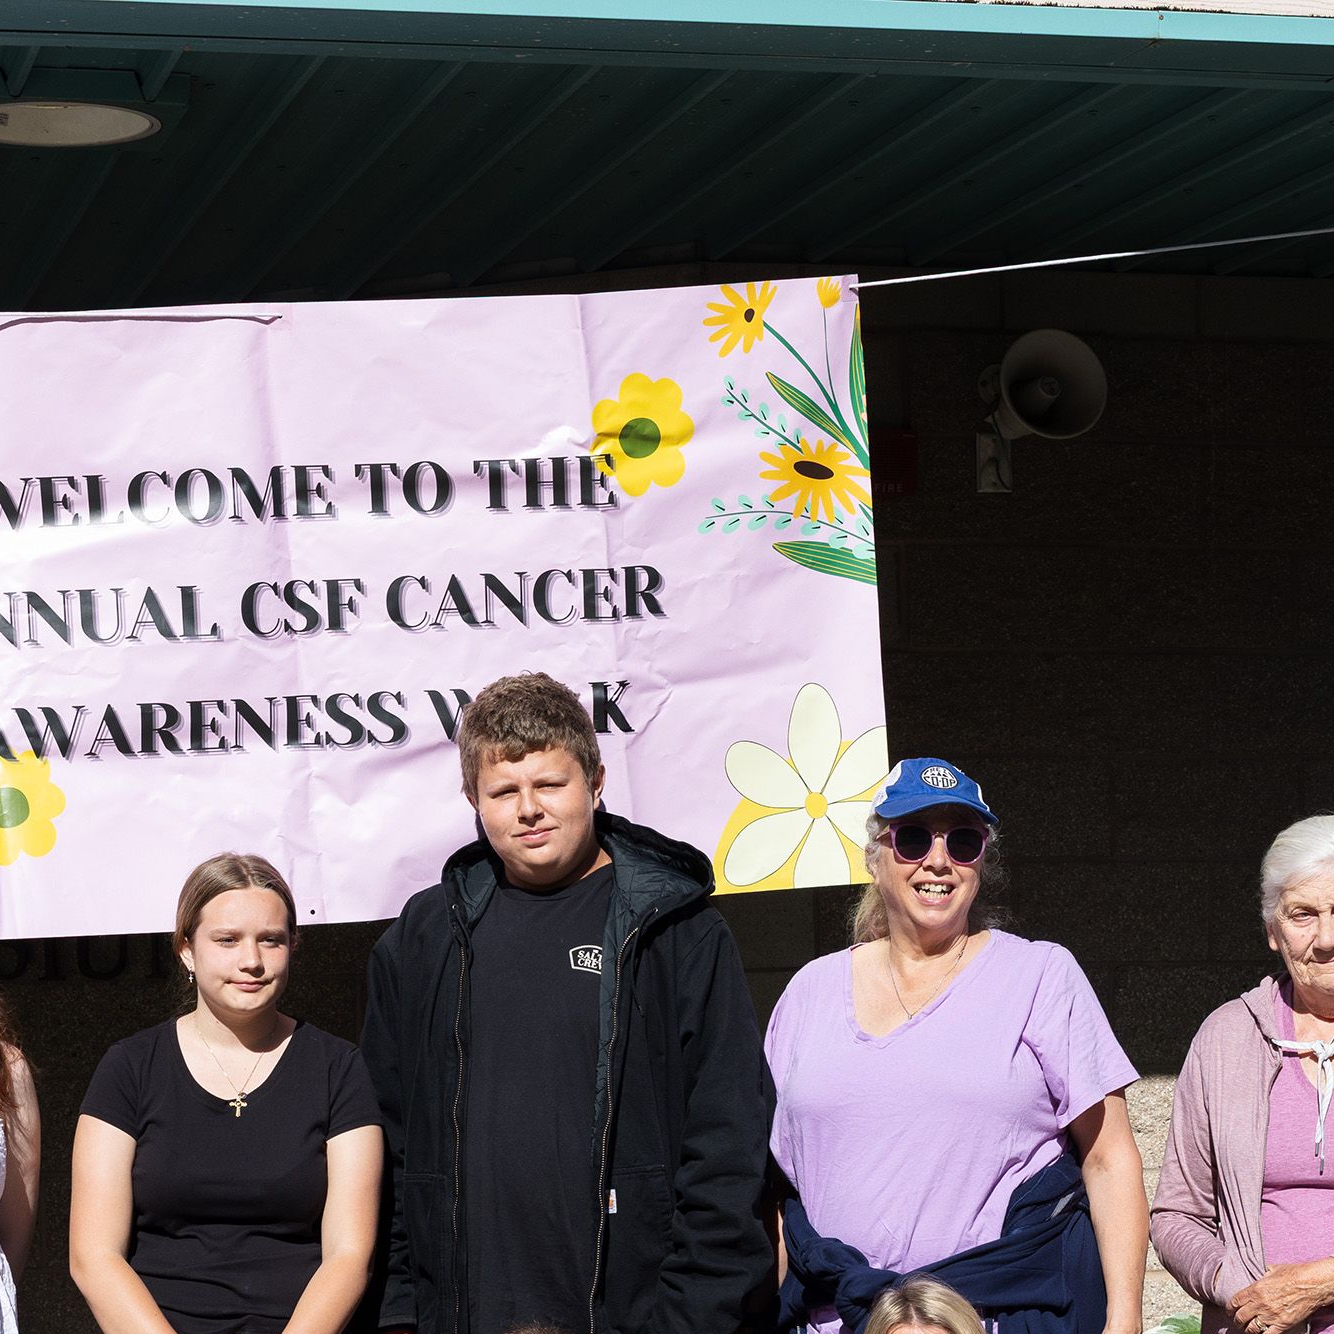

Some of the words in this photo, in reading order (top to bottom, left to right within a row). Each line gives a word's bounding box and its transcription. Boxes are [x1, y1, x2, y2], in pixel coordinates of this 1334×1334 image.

[355, 461, 455, 517] TO
[472, 453, 619, 511] THE
[241, 578, 366, 637] CSF
[386, 565, 669, 629] CANCER
[424, 680, 635, 742] WK
